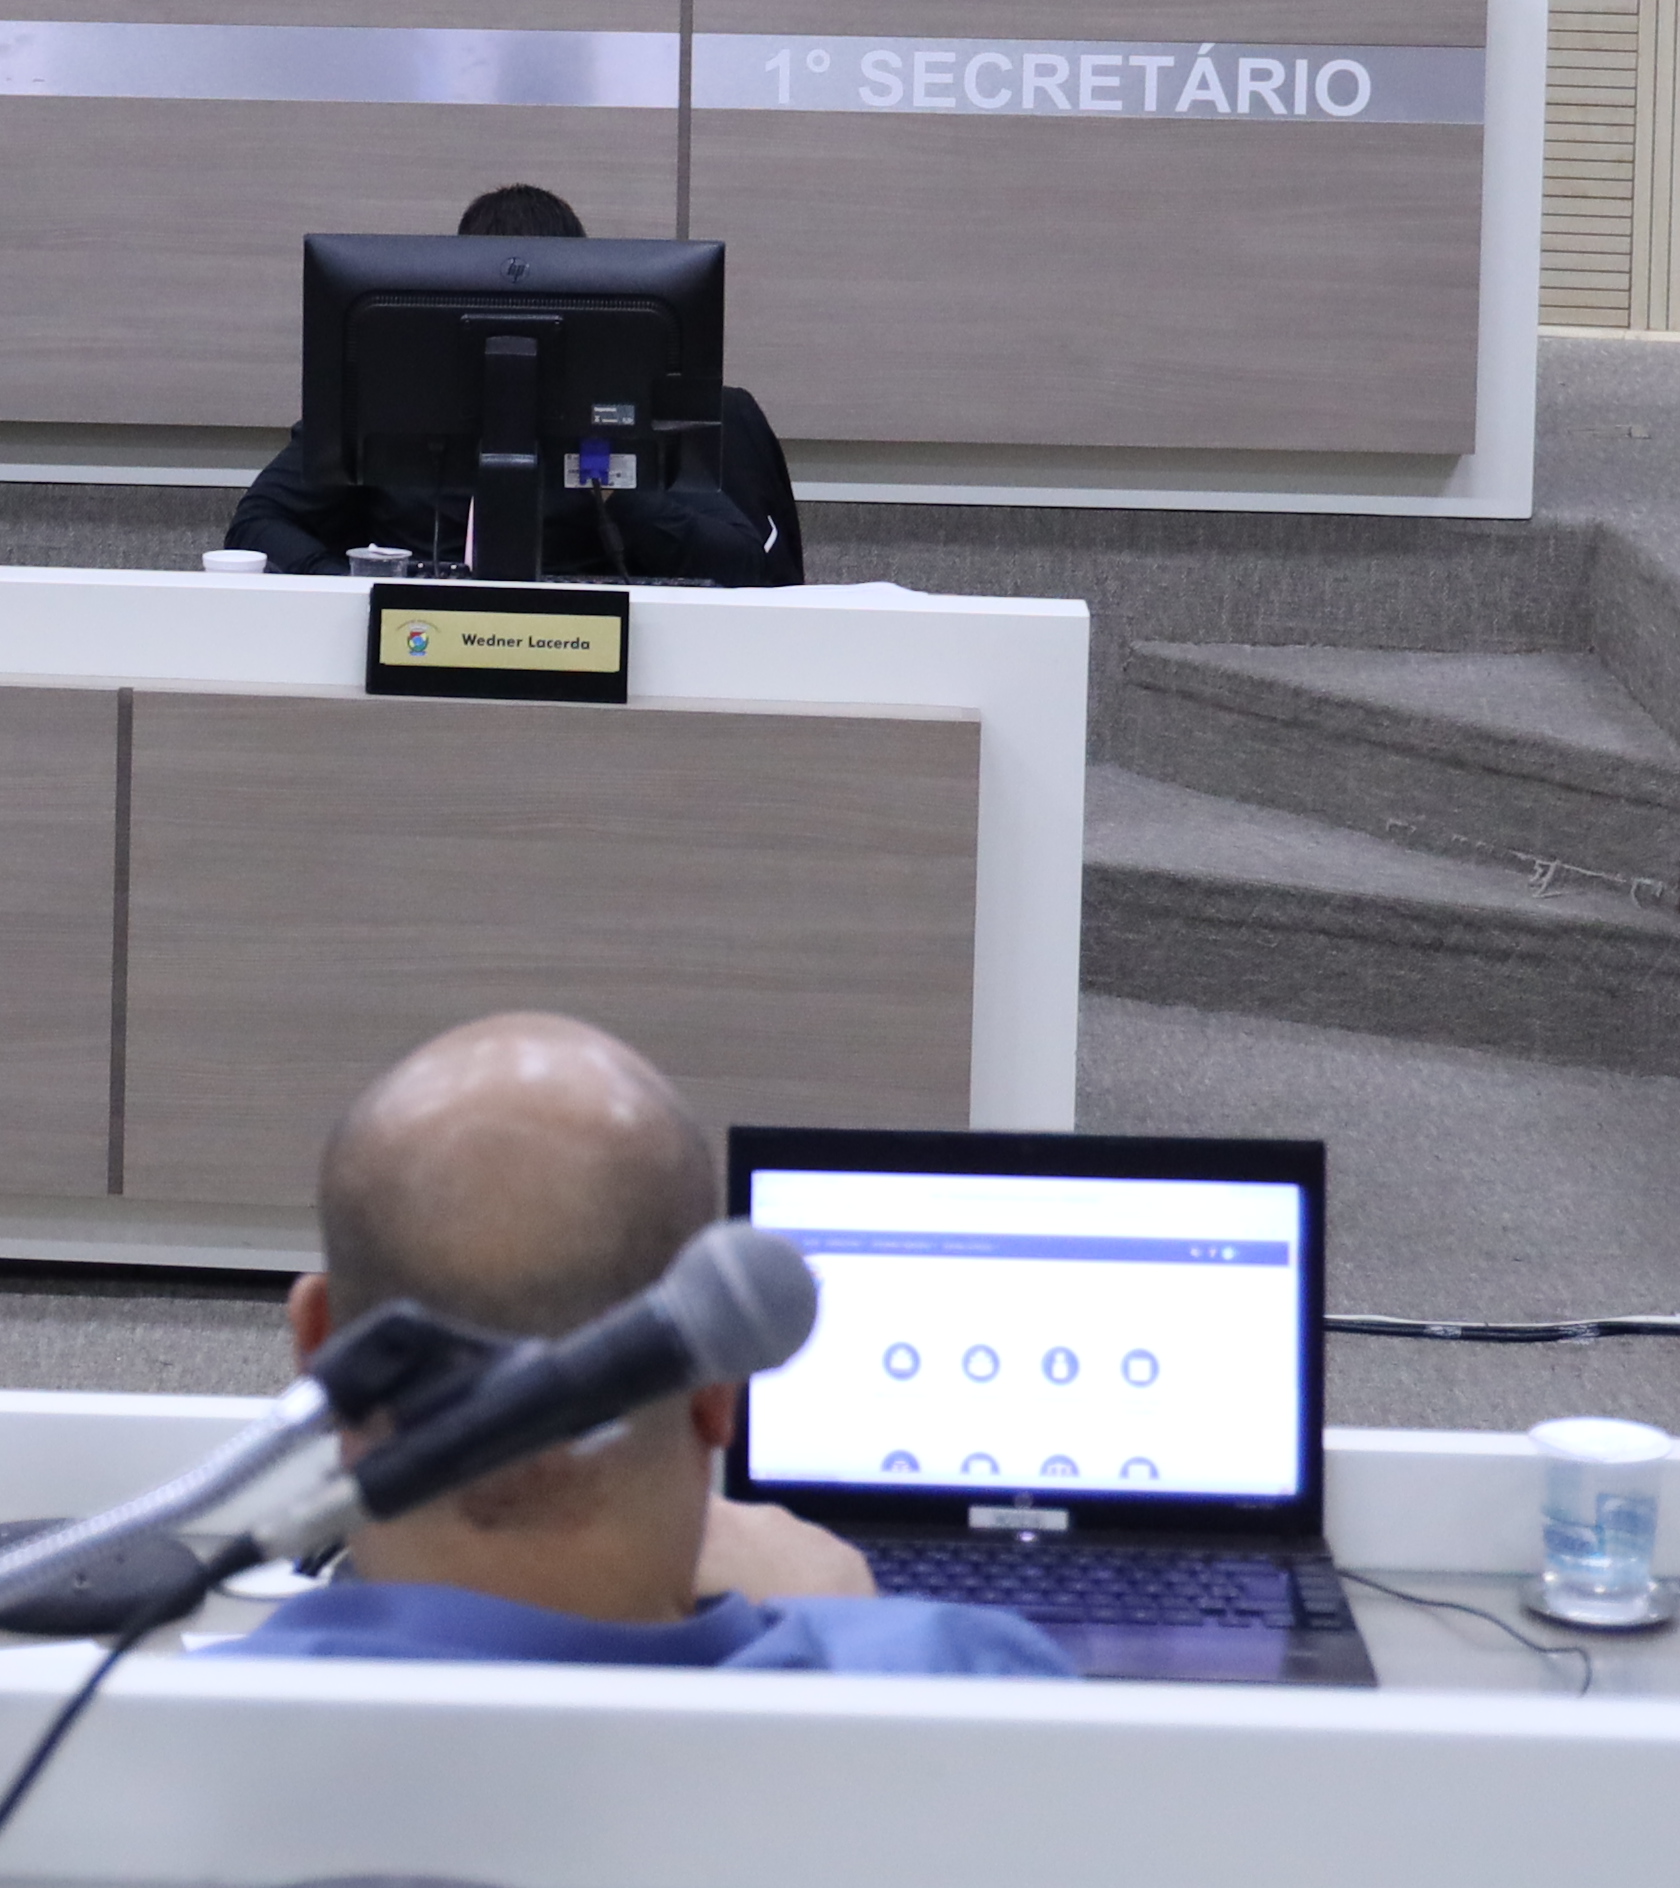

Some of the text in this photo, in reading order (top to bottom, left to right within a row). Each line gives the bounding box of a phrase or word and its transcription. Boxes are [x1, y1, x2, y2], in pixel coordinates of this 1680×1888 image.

[858, 41, 1370, 117] SECRETÁRIO
[462, 634, 589, 649] Wedner Lacerda
